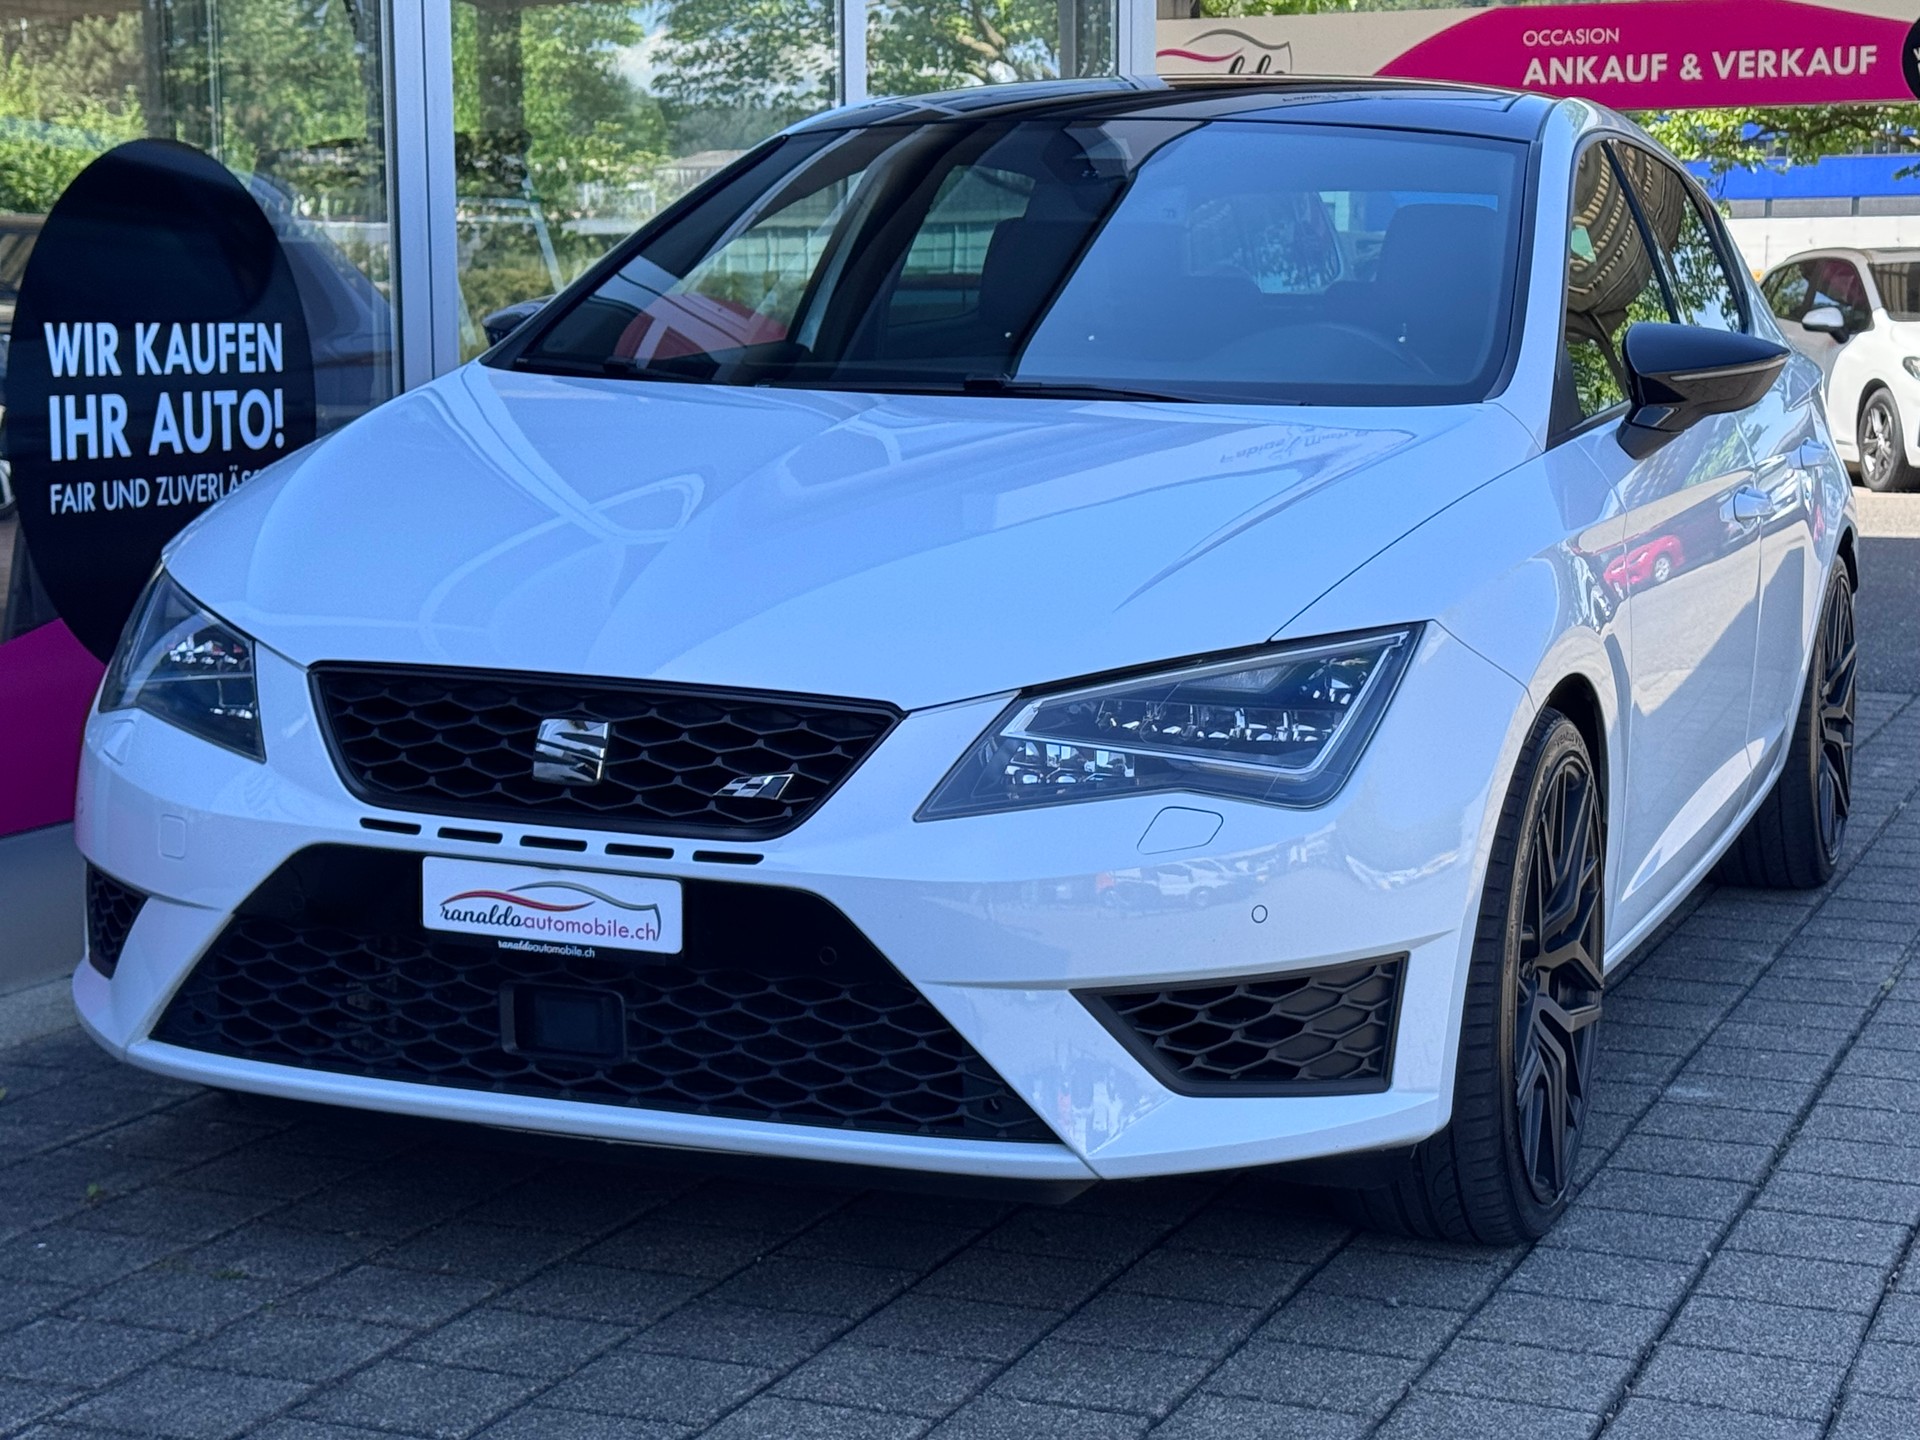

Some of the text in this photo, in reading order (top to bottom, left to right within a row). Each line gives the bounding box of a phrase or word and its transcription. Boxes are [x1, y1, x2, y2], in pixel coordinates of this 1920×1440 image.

[1522, 28, 1620, 47] OCCASION
[1522, 53, 1669, 86] ANKAUF
[1679, 54, 1703, 81] &
[1712, 45, 1878, 80] VERKAUF
[44, 322, 284, 377] WIR KAUFEN
[49, 388, 285, 462] IHR AUTO!
[50, 482, 96, 515] FAIR
[102, 478, 150, 511] UND
[440, 904, 658, 941] ranaldoautomobile.ch
[497, 940, 596, 958] ranaldoautomobile.ch
